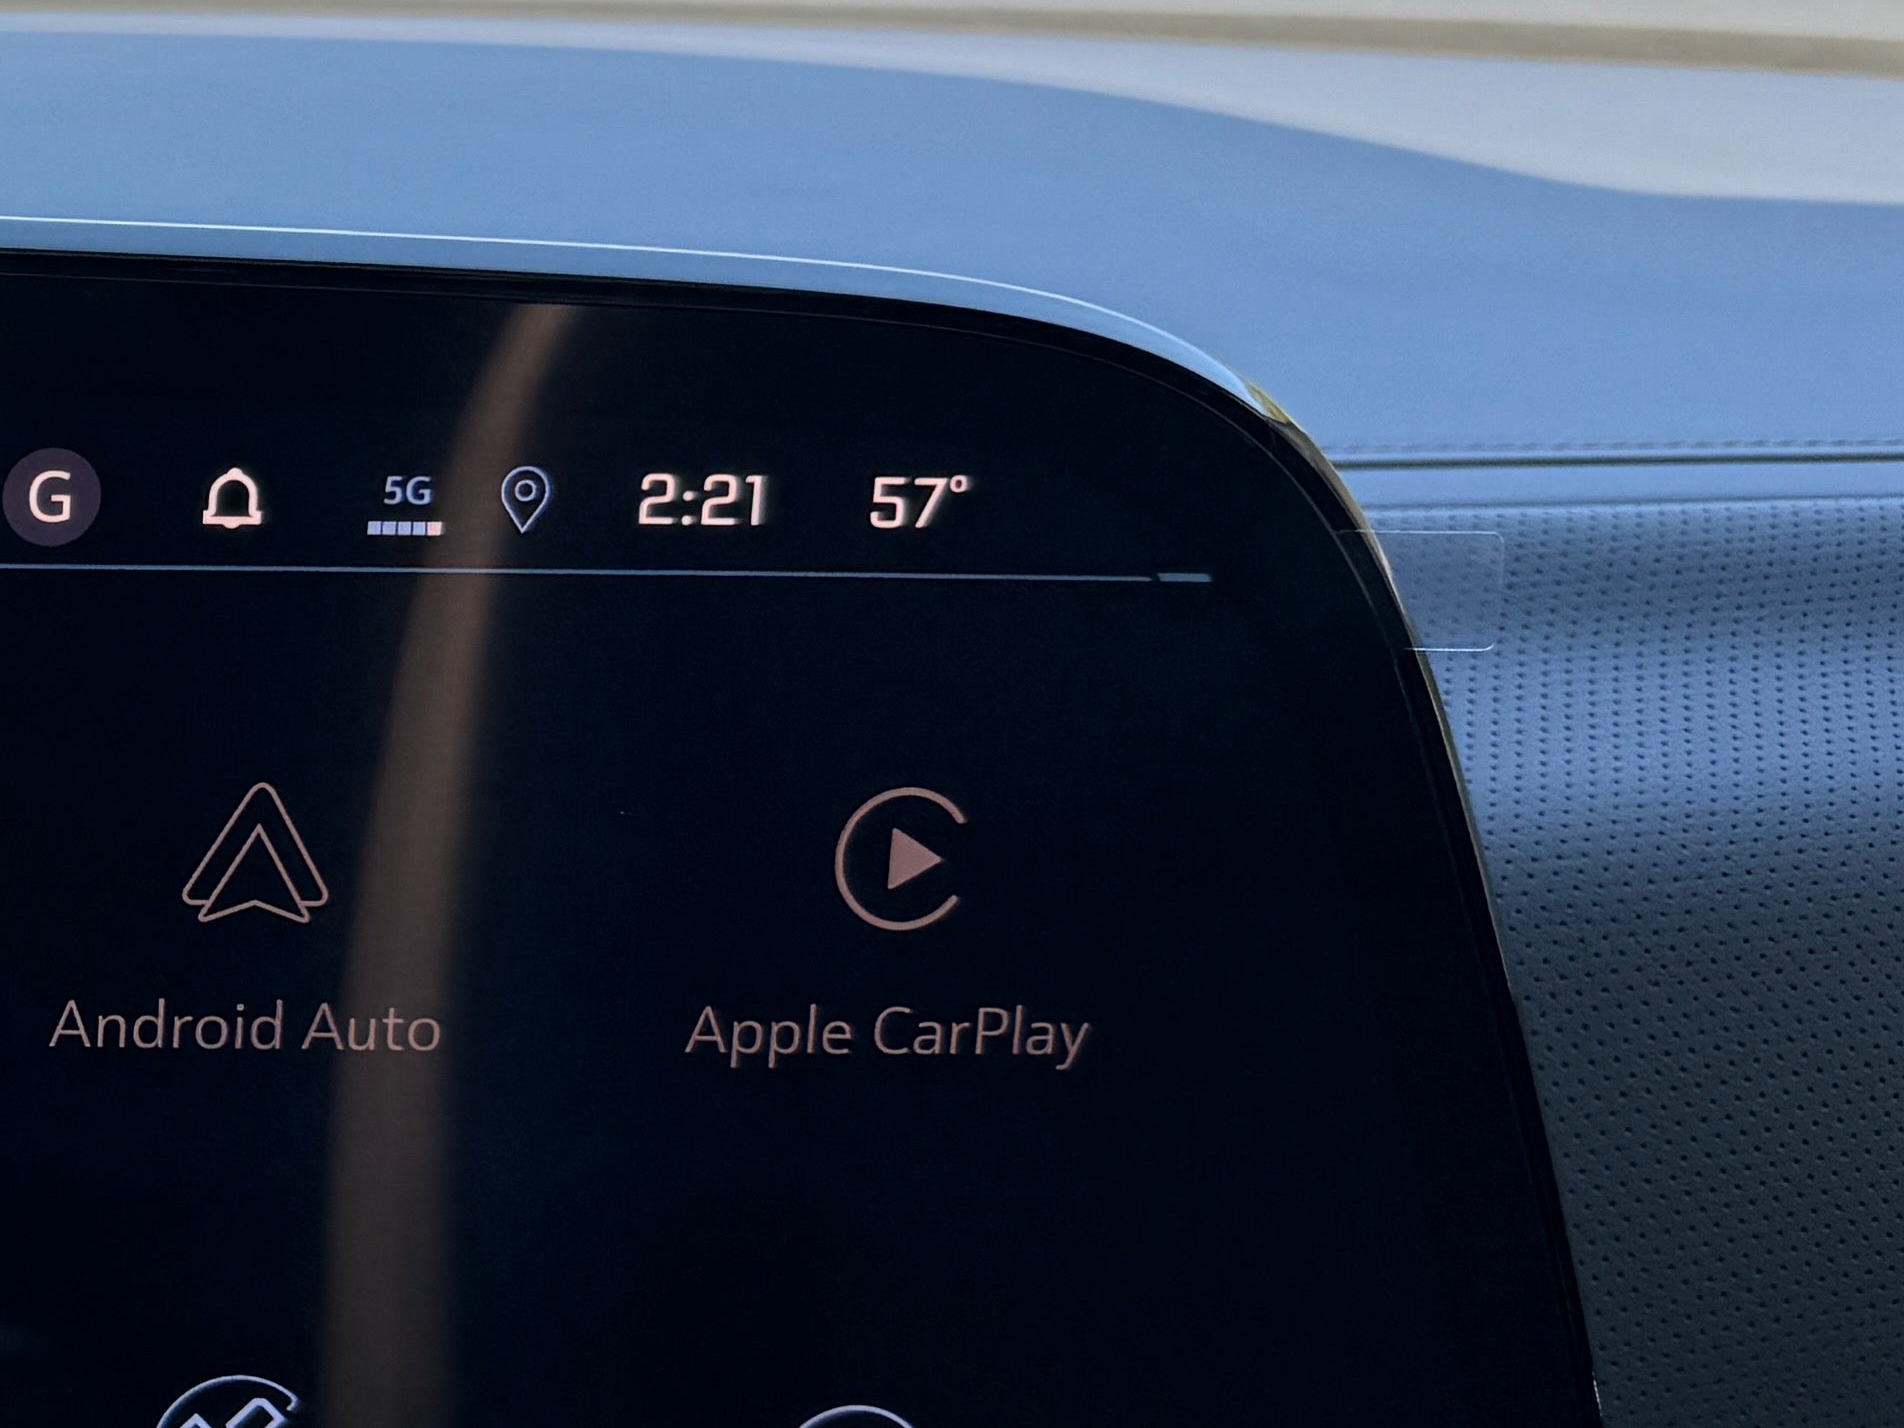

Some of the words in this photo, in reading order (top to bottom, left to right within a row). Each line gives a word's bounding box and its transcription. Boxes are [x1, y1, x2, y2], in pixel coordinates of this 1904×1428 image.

[383, 475, 432, 505] 5G
[638, 472, 765, 526] 2:21
[49, 998, 283, 1050] Android
[301, 1002, 442, 1052] Auto
[685, 1003, 852, 1068] Apple
[874, 1004, 1089, 1069] CarPlay
